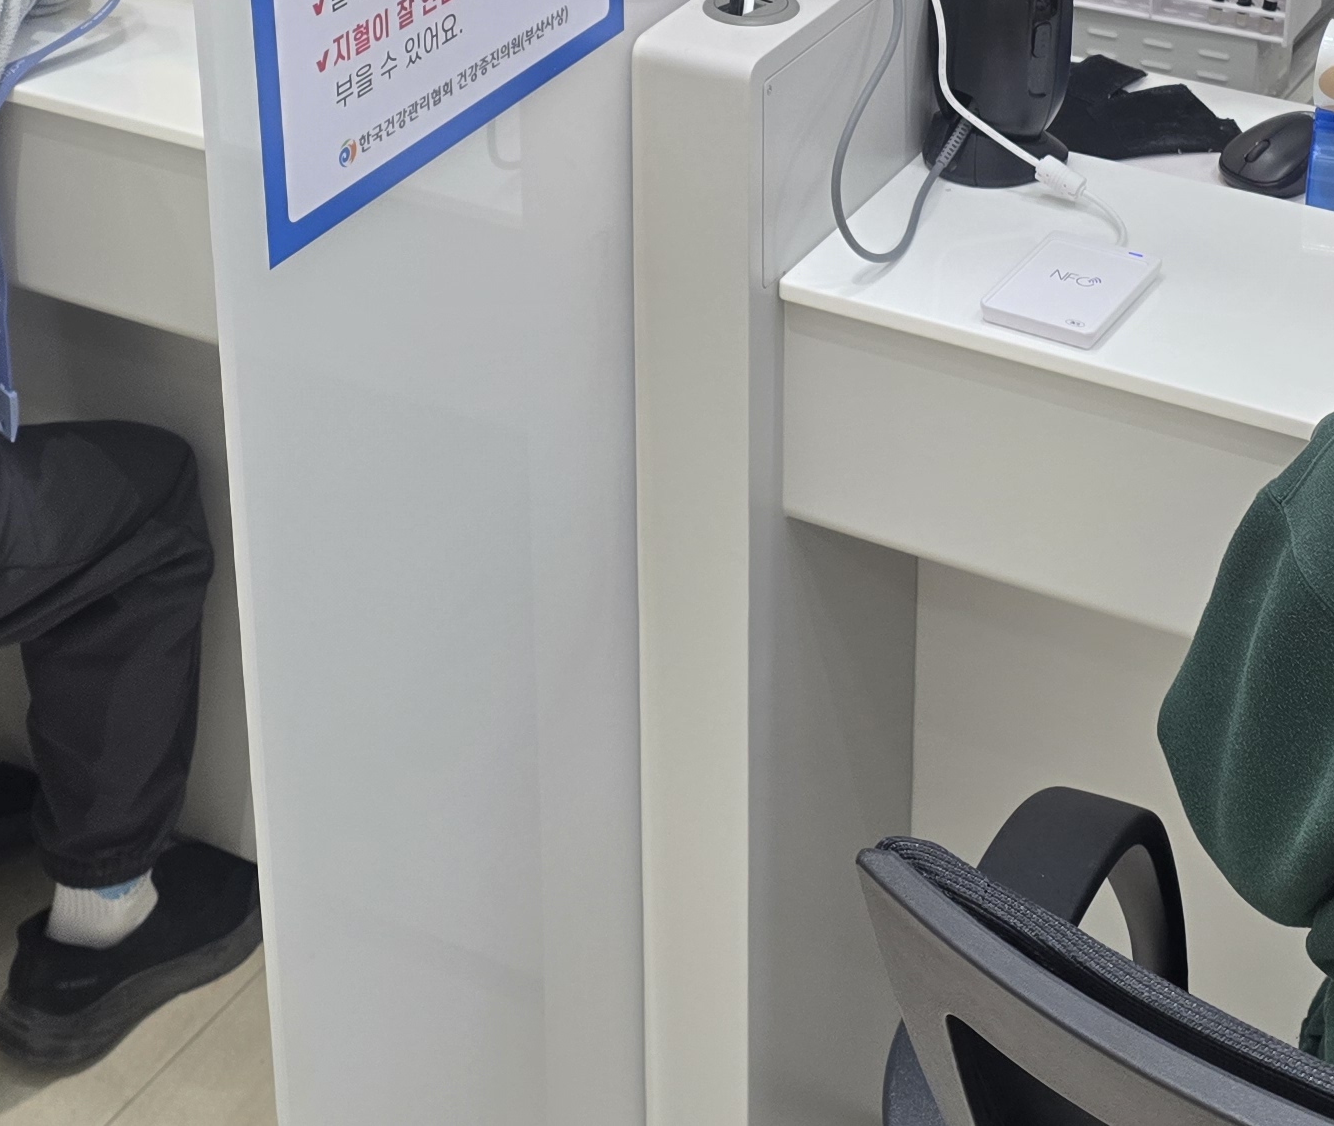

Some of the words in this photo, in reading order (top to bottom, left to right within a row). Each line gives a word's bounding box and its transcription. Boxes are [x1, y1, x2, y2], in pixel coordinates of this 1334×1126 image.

[332, 8, 390, 66] 지혈이
[335, 63, 374, 108] 부을
[380, 50, 398, 79] 수
[404, 13, 463, 69] 있어요.
[358, 78, 453, 153] 한국건강관리협회
[456, 4, 569, 90] 건강증진의원(부산사상)
[1050, 269, 1095, 287] NFC
